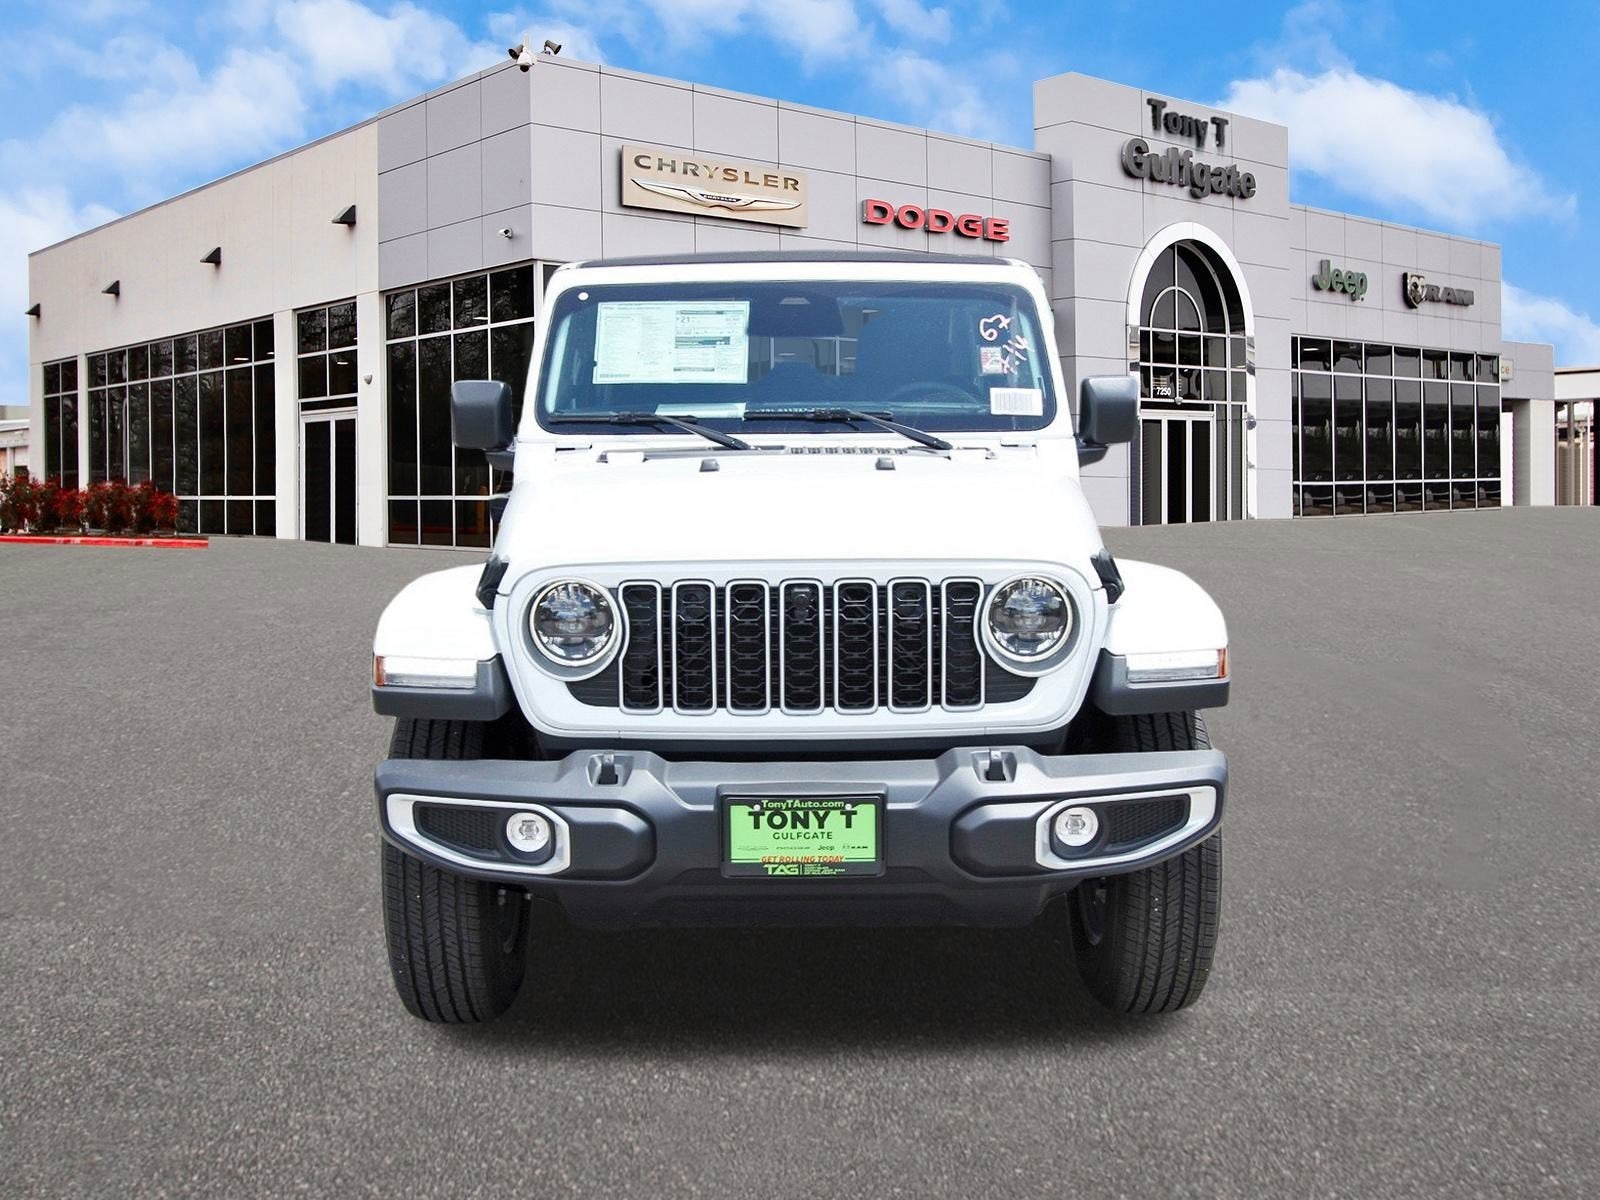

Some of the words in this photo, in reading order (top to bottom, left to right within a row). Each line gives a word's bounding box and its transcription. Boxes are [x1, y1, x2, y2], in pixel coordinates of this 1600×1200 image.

[1146, 97, 1208, 147] Tony
[1210, 116, 1229, 147] T
[633, 153, 801, 192] CHRYSLER
[1121, 138, 1256, 199] Gulfgate
[861, 198, 1010, 243] DODGE
[1311, 259, 1369, 302] Jeep
[1423, 284, 1475, 307] RAM
[761, 799, 844, 809] TonyTAuto.com
[748, 810, 831, 830] TONY
[840, 810, 857, 828] T
[772, 831, 833, 840] GULFGATE
[761, 855, 777, 864] GET
[779, 855, 815, 864] ROLLING
[817, 855, 845, 863] TODAY
[763, 864, 798, 875] TAG
